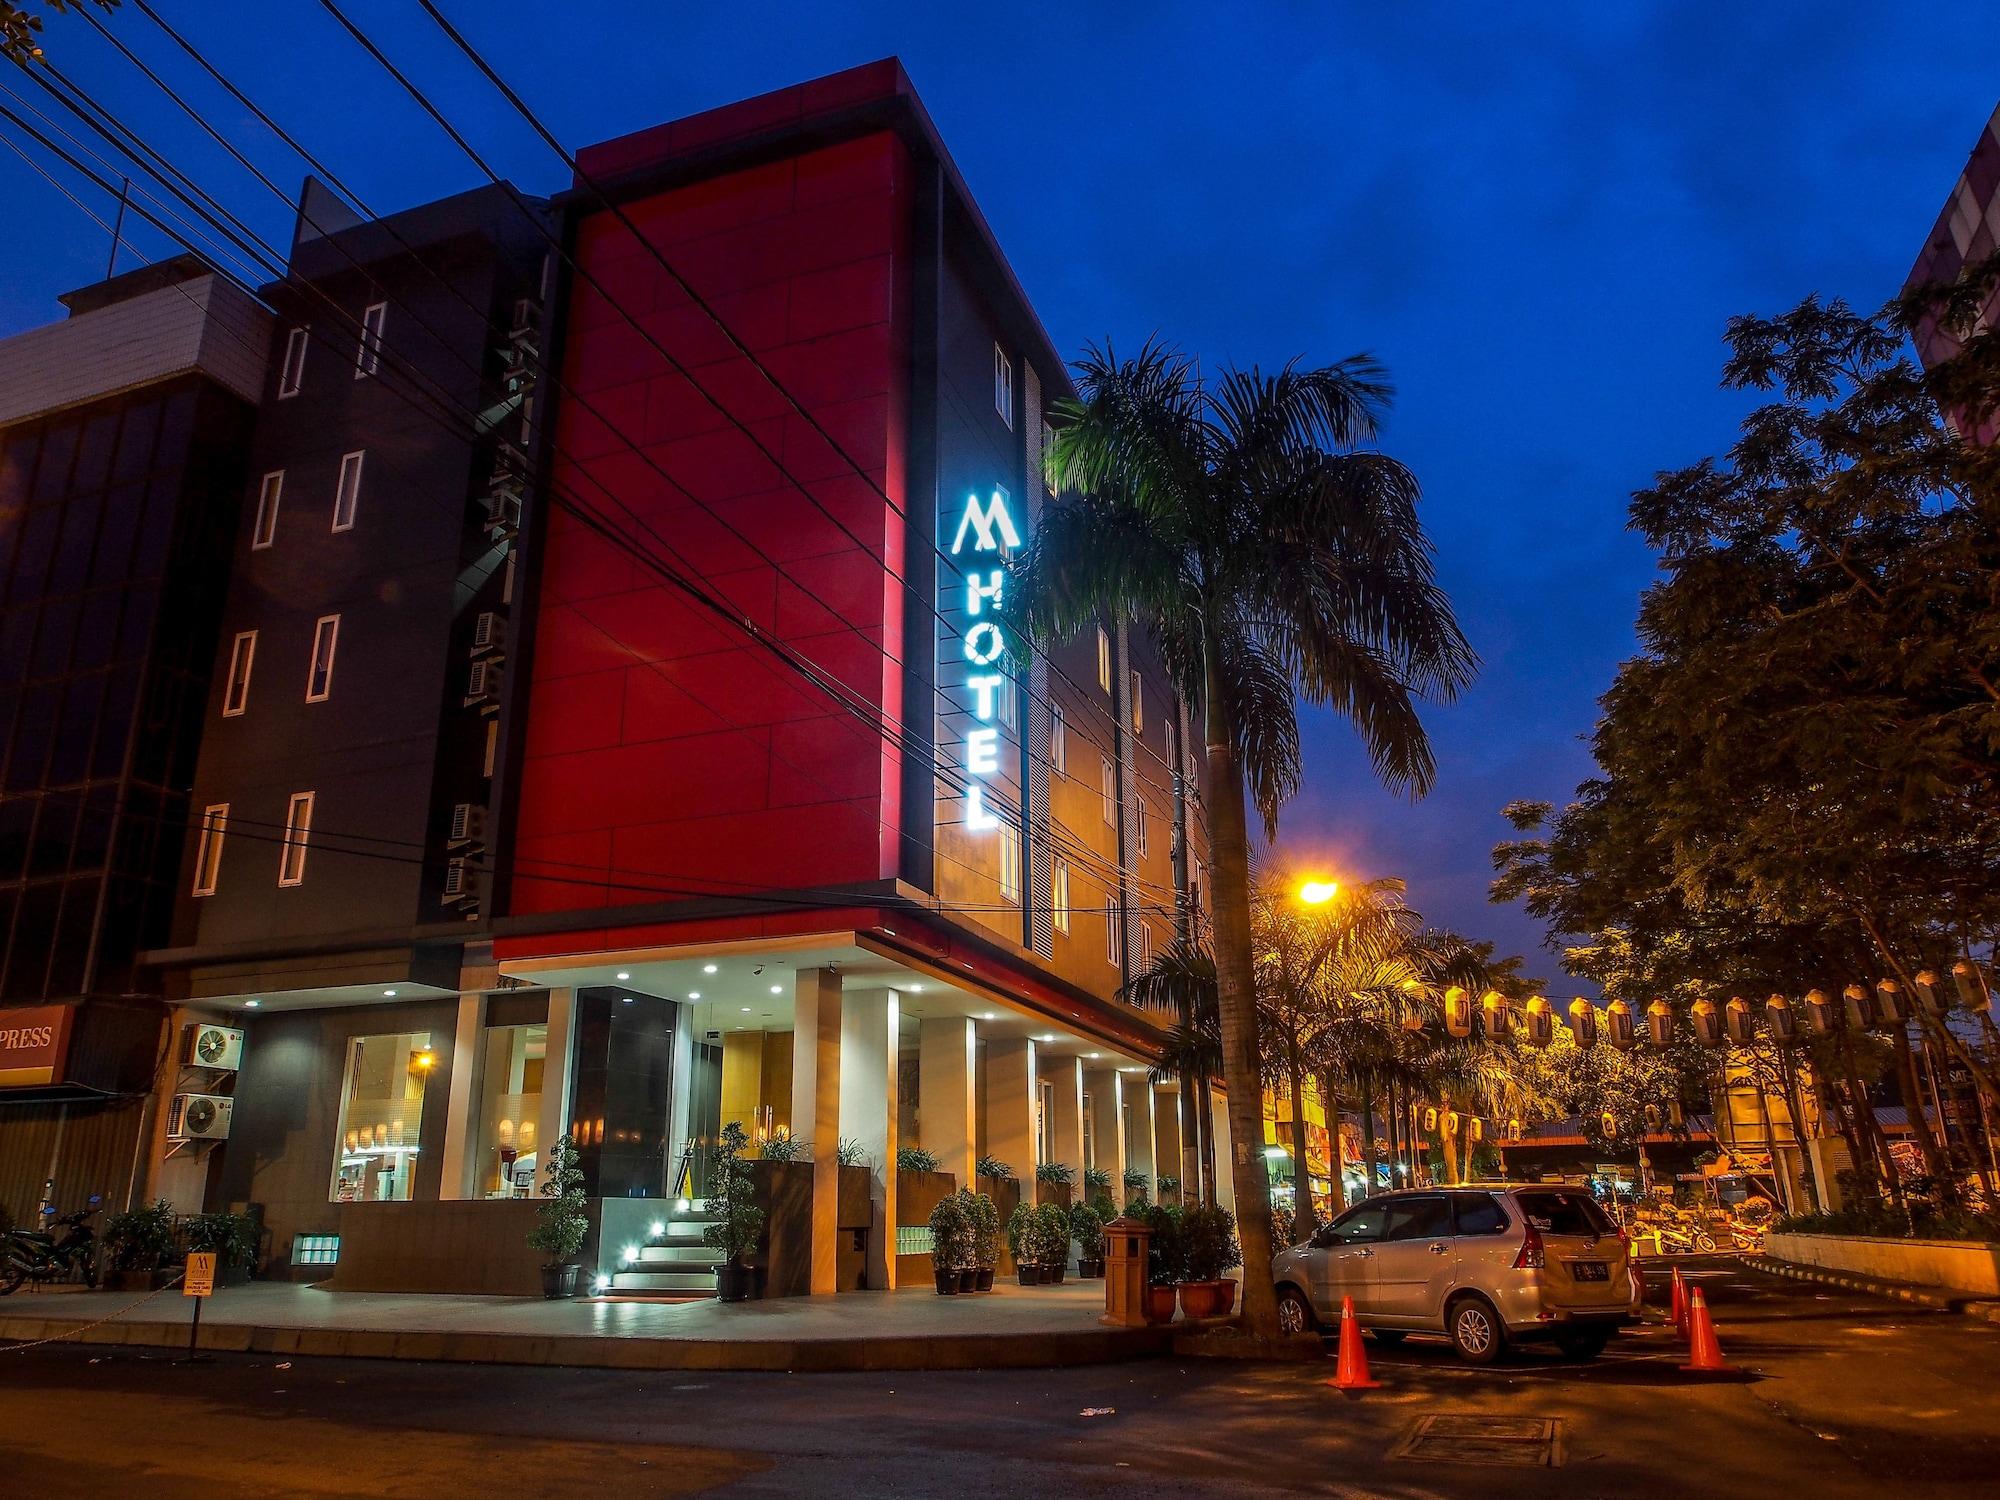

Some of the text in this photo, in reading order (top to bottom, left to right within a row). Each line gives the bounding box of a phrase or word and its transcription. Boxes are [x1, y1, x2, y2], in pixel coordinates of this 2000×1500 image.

[951, 490, 1021, 831] M HOTEL
[0, 1026, 52, 1050] PRESS
